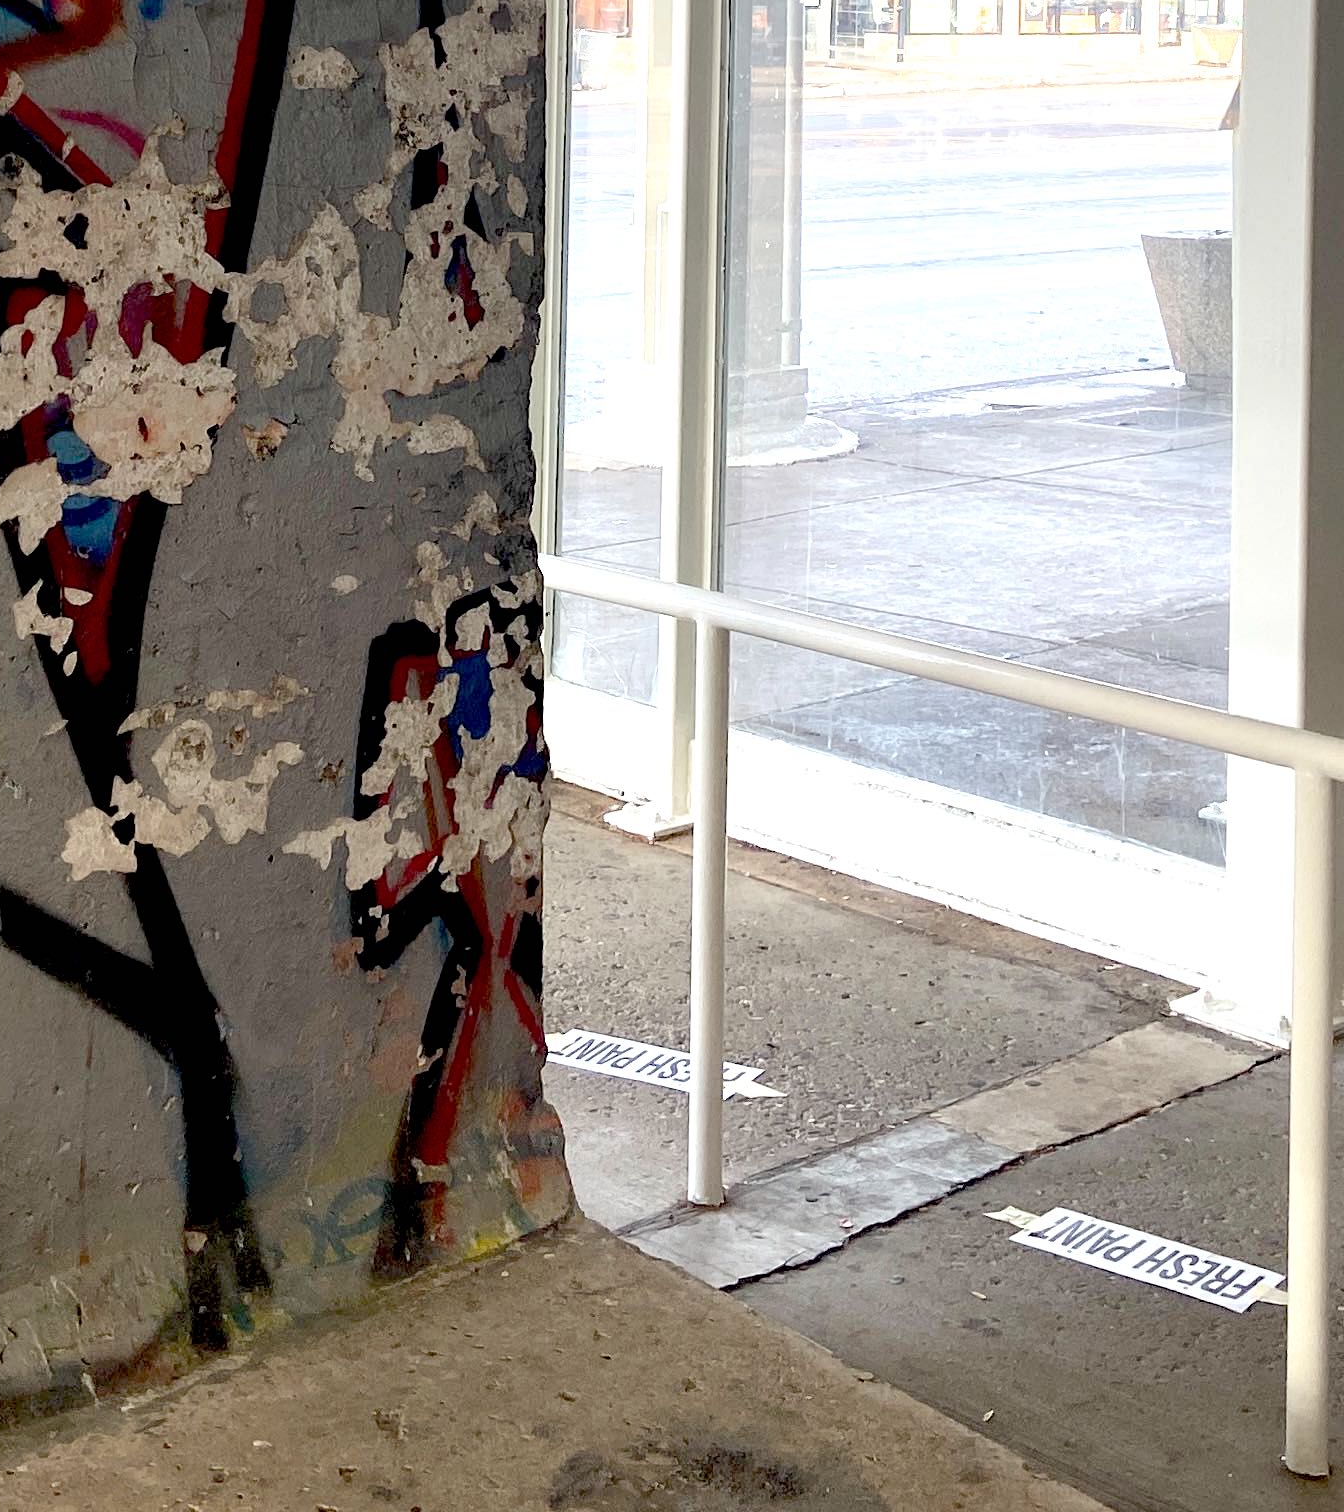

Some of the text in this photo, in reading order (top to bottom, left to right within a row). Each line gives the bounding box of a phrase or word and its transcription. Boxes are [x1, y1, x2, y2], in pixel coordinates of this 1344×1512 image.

[547, 1036, 648, 1070] PAINT
[1027, 1216, 1265, 1300] FRESH PAINT
